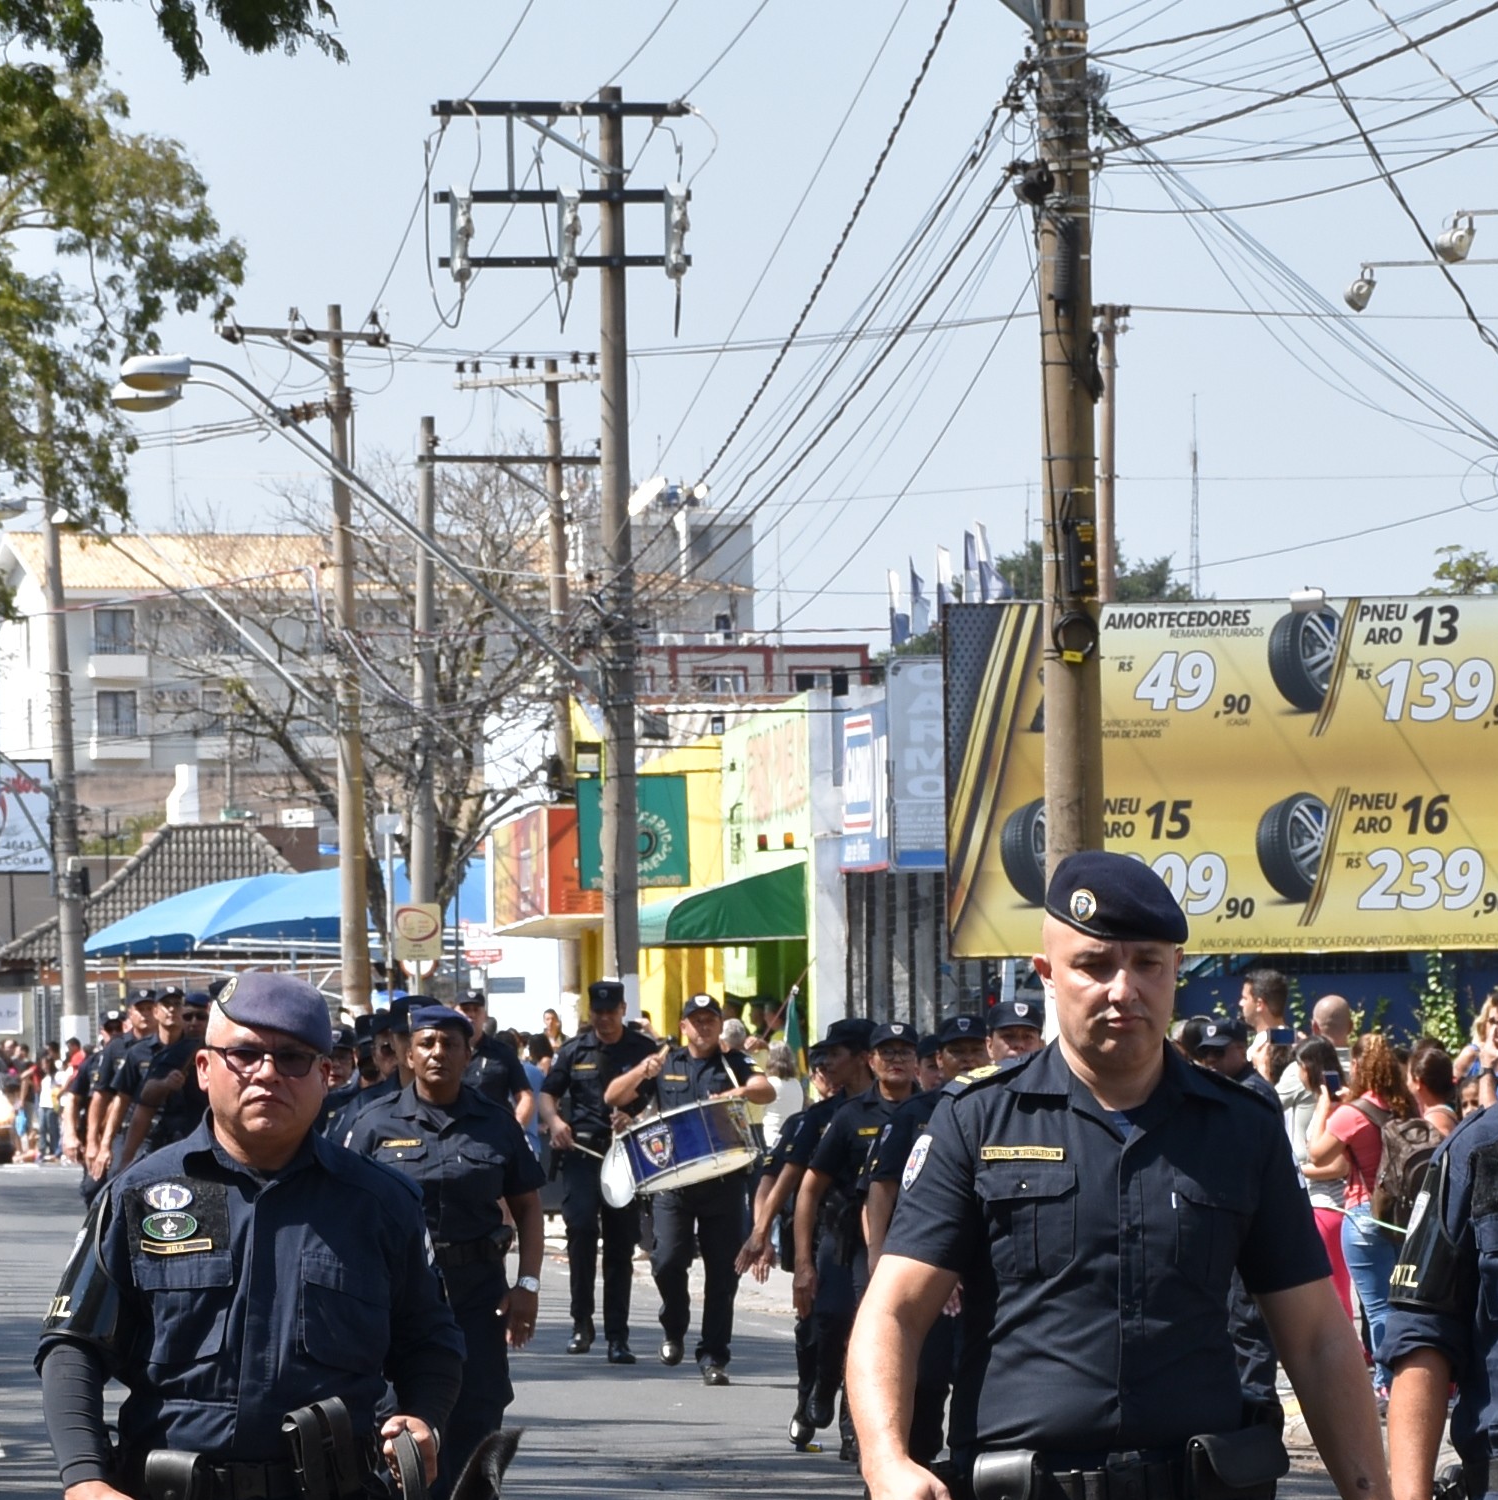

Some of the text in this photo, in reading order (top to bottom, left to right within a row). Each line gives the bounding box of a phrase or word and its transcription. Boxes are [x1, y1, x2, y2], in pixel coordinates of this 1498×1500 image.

[1104, 609, 1251, 631] AMORTECEDORES
[1169, 627, 1264, 639] REMANUFATURADOS
[1358, 603, 1460, 646] PNEU 13
[1363, 627, 1403, 646] ARO
[1134, 650, 1217, 712] 49
[1214, 693, 1251, 719] ,90
[1376, 657, 1495, 722] 139
[1103, 798, 1192, 839] NEU 15
[1348, 793, 1450, 835] PNEU 16
[1353, 815, 1392, 834] ARO
[1115, 851, 1255, 924] 09 ,90
[1356, 846, 1486, 911] 239
